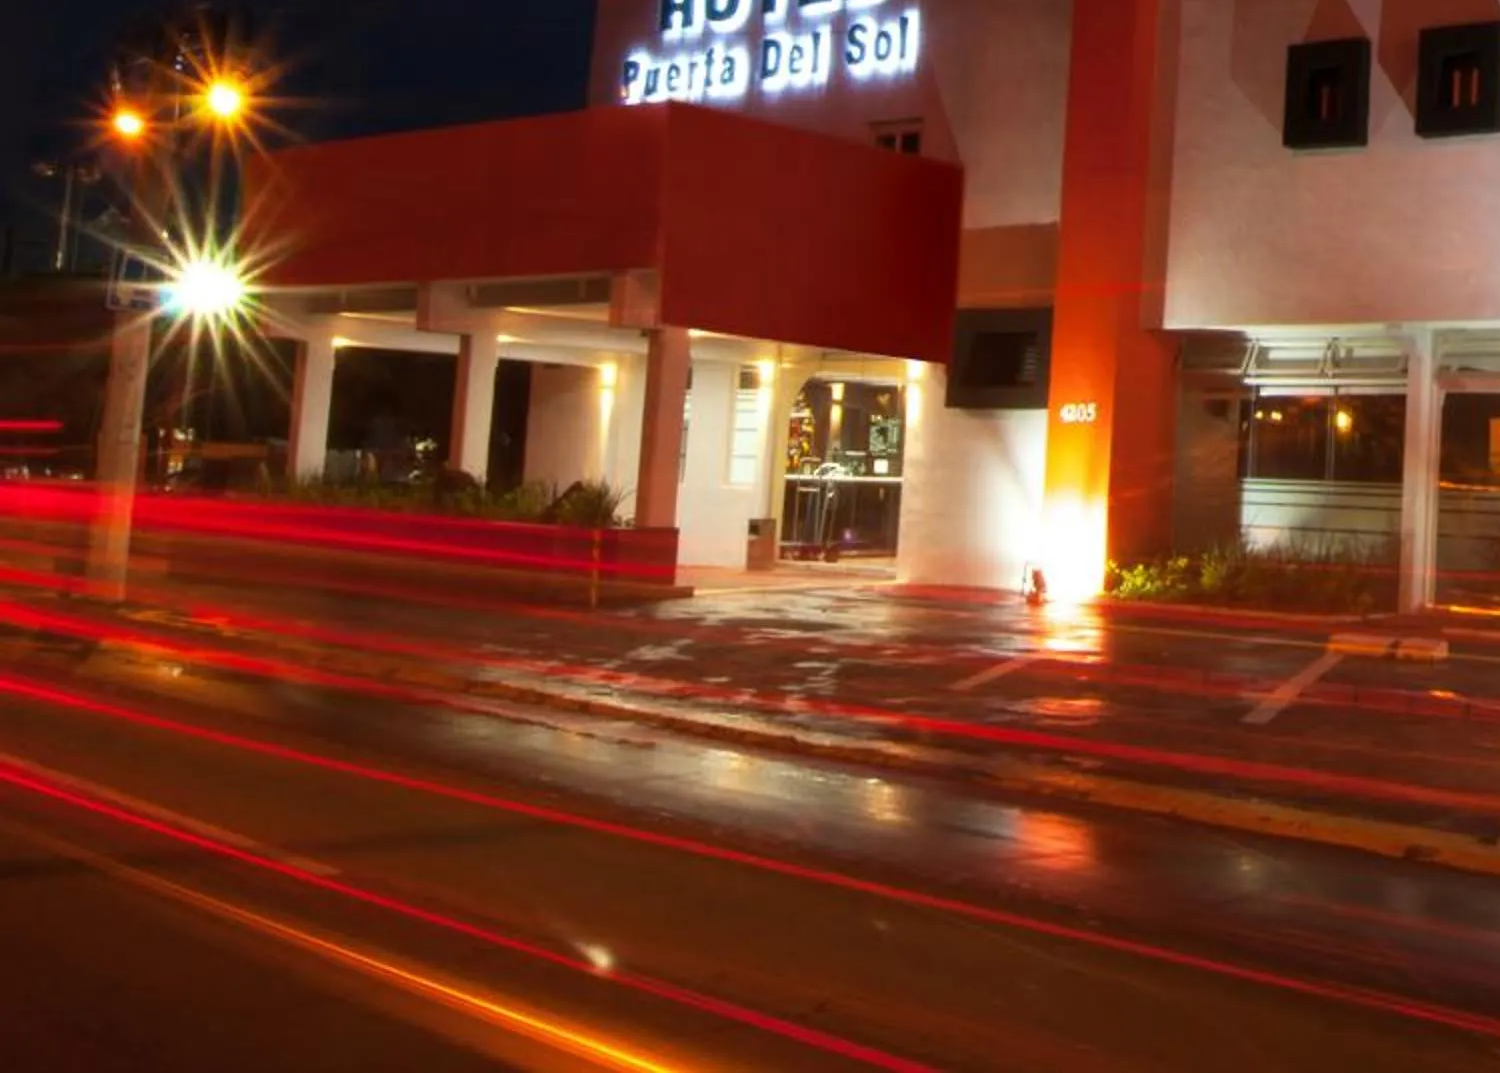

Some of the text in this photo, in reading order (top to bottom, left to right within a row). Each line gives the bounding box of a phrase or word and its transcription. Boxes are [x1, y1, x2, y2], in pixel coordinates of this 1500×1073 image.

[622, 13, 910, 100] Puerta Del Sol
